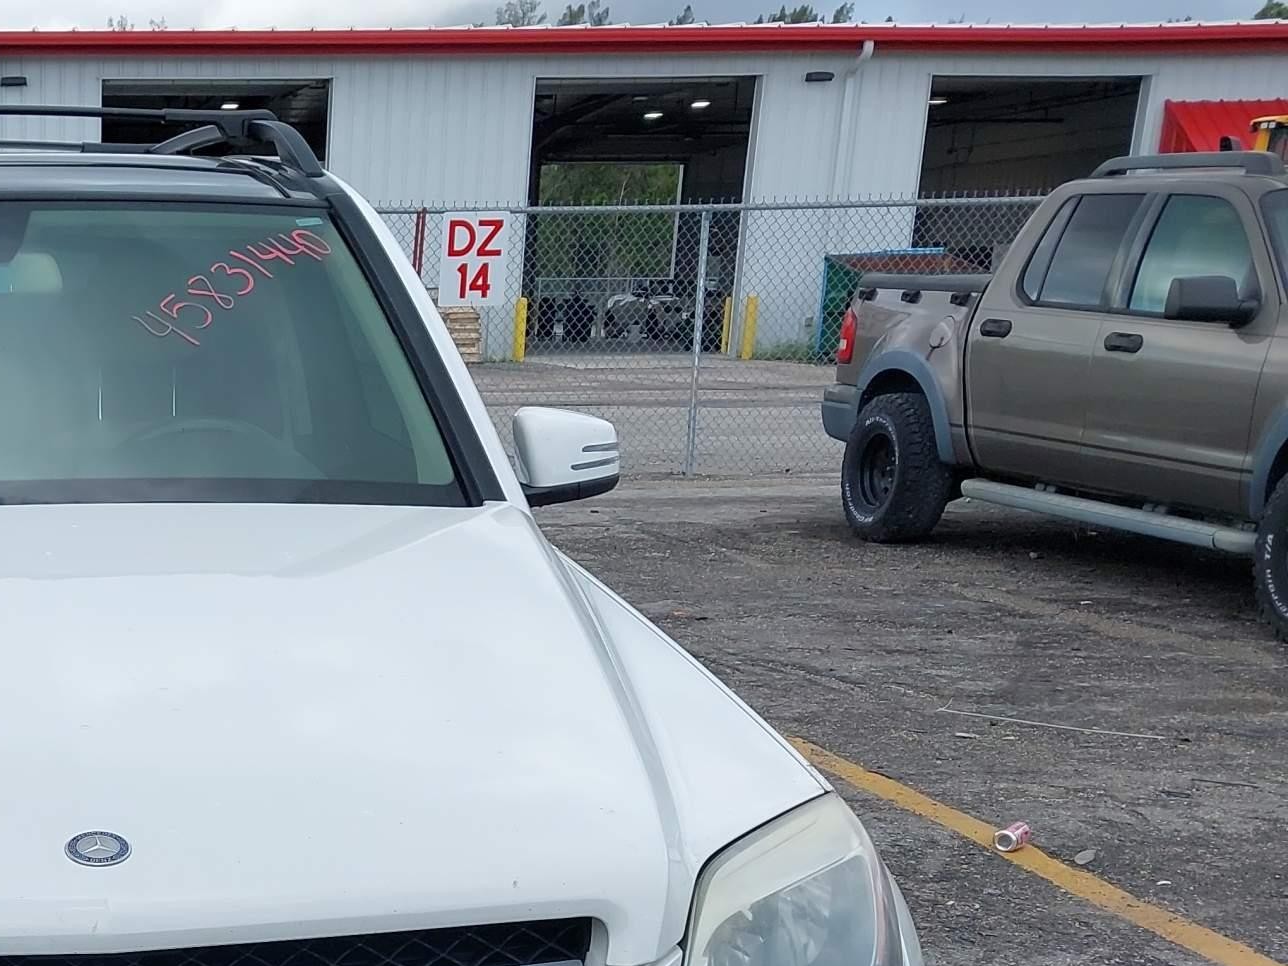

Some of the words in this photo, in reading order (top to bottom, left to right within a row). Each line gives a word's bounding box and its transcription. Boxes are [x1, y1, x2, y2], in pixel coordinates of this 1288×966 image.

[447, 219, 505, 257] DZ
[131, 228, 332, 346] 45831440
[456, 262, 491, 299] 14
